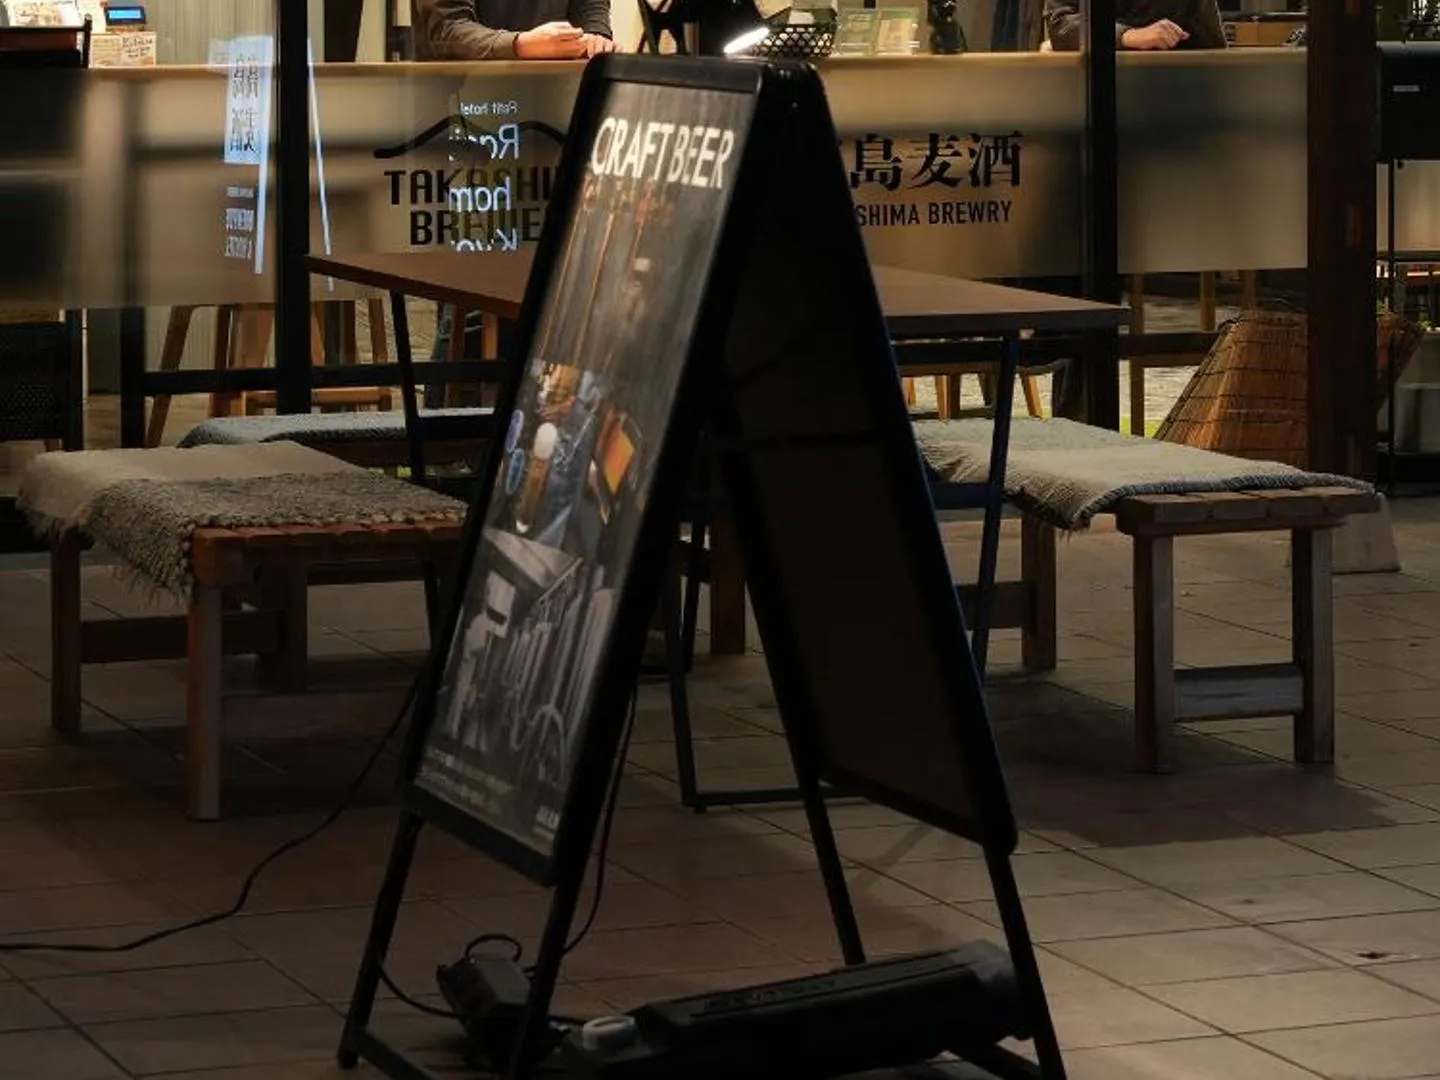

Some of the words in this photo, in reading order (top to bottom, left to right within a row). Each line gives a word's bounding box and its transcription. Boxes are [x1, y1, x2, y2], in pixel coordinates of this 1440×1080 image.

[591, 117, 674, 181] CRAFT
[665, 125, 734, 189] BEER
[844, 131, 1024, 191] 島麦酒
[384, 168, 549, 205] TAKASHI
[410, 207, 541, 246] BREWE
[856, 203, 920, 226] SHIMA
[928, 201, 1012, 224] BREWRY
